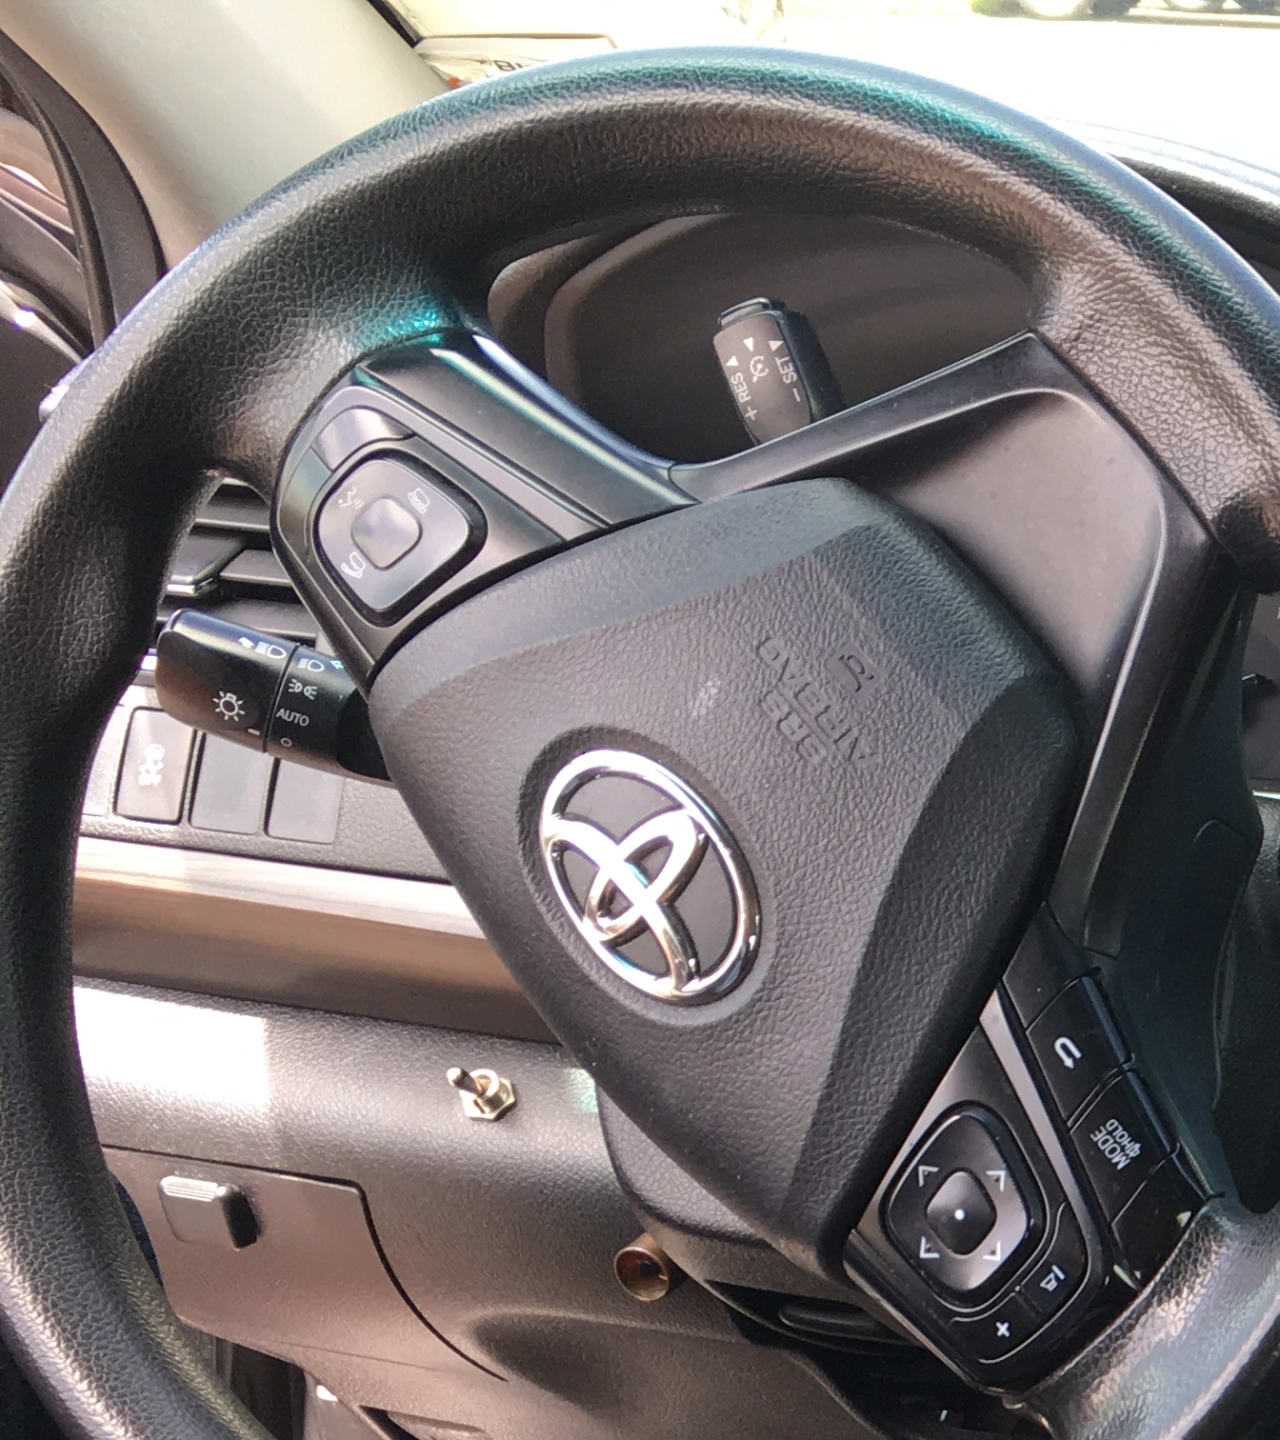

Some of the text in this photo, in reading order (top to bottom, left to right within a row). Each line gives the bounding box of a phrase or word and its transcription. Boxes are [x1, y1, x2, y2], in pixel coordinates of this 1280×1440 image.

[775, 356, 797, 384] SET
[731, 372, 751, 403] RES
[276, 708, 310, 727] AUTO
[1089, 1125, 1131, 1171] MODE
